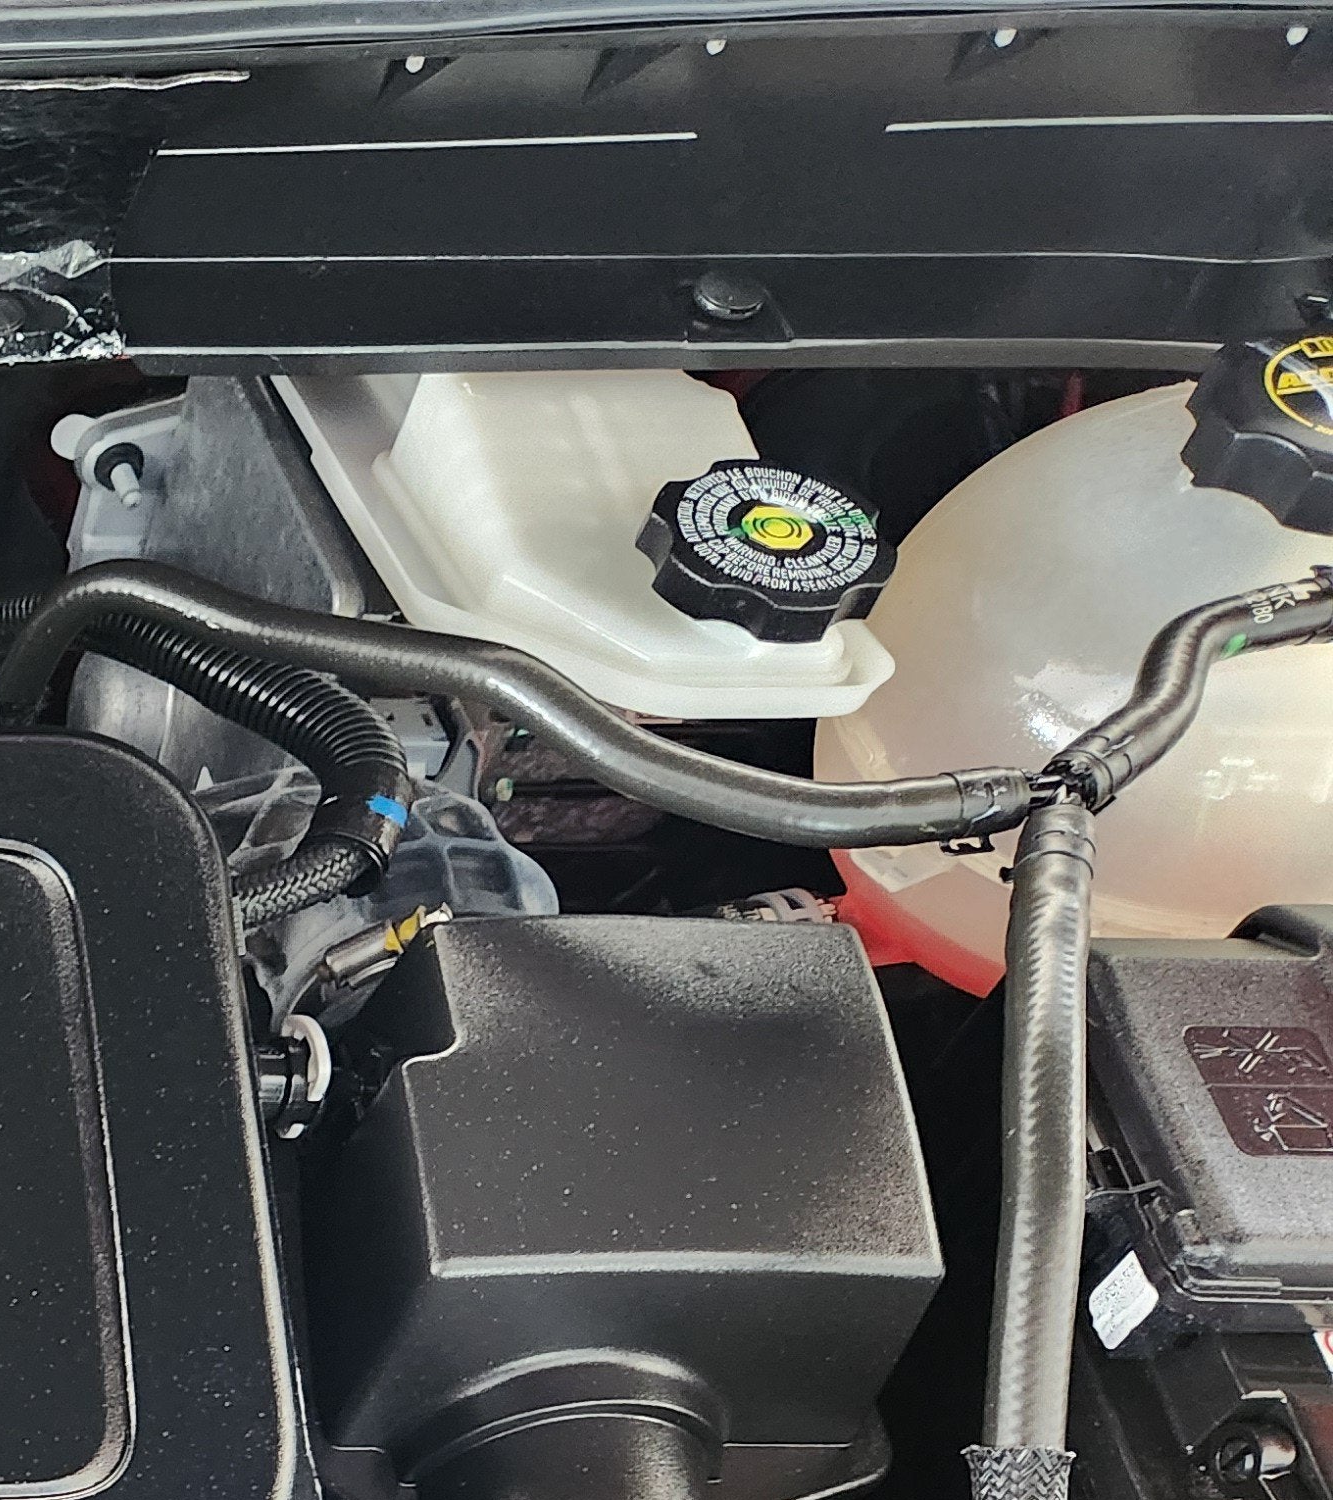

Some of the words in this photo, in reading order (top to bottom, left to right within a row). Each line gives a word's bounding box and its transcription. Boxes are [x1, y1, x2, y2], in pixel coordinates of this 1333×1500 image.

[683, 470, 730, 500] NETTOYER
[726, 467, 744, 480] LE
[743, 466, 802, 485] BOUCHON
[801, 477, 841, 500] AVANT
[836, 496, 856, 511] LA
[710, 482, 734, 498] QUE
[731, 478, 750, 491] DU
[750, 478, 796, 493] LIQUIDE
[798, 486, 816, 499] DE
[813, 494, 846, 518] FREIN
[707, 538, 731, 554] CAP
[724, 551, 772, 576] BEFORE
[829, 555, 852, 571] USE
[716, 560, 753, 582] FLUID
[751, 574, 790, 591] FROM
[792, 580, 801, 592] A
[801, 574, 846, 592] SEALED
[839, 543, 878, 583] CONTAINER
[783, 554, 822, 570] CLEAN
